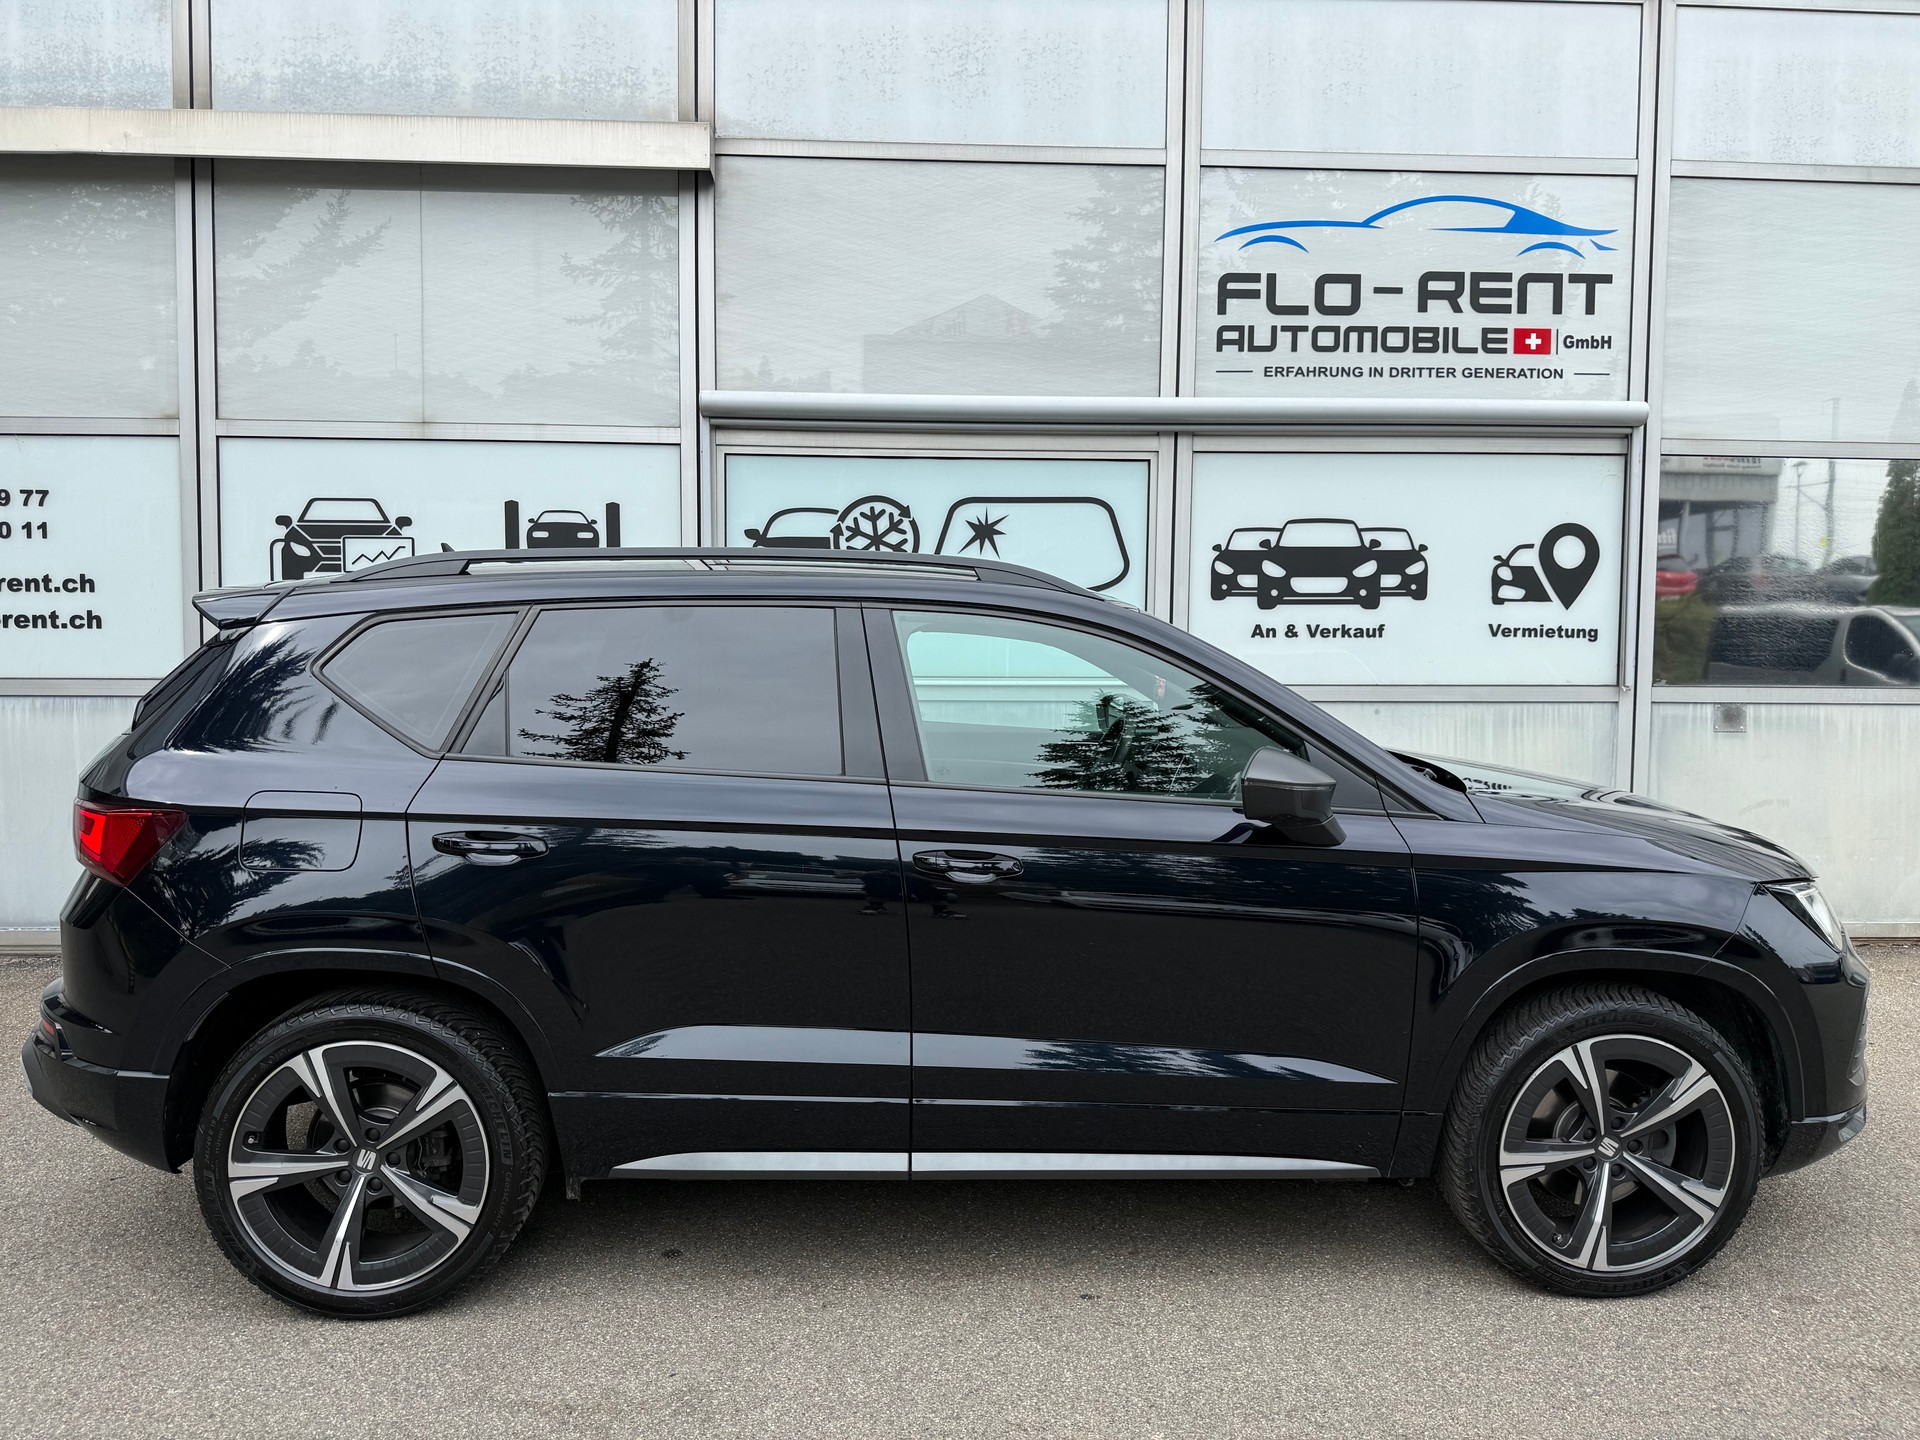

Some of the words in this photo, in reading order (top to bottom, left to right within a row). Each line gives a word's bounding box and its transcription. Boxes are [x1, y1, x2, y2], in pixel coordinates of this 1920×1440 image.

[1216, 325, 1508, 354] AUTOMOBILE
[1563, 334, 1612, 351] GmbH
[1263, 366, 1364, 379] ERFAHRUNG
[1368, 366, 1384, 379] IN
[1389, 366, 1457, 379] DRITTER
[1461, 367, 1564, 380] GENERATION
[20, 489, 49, 507] 77
[21, 521, 48, 539] 11
[1250, 623, 1277, 639] An
[1284, 623, 1300, 639] &
[1306, 623, 1386, 639] Verkauf
[1488, 623, 1600, 642] Vermietung
[476, 1081, 513, 1165] MICHELIN
